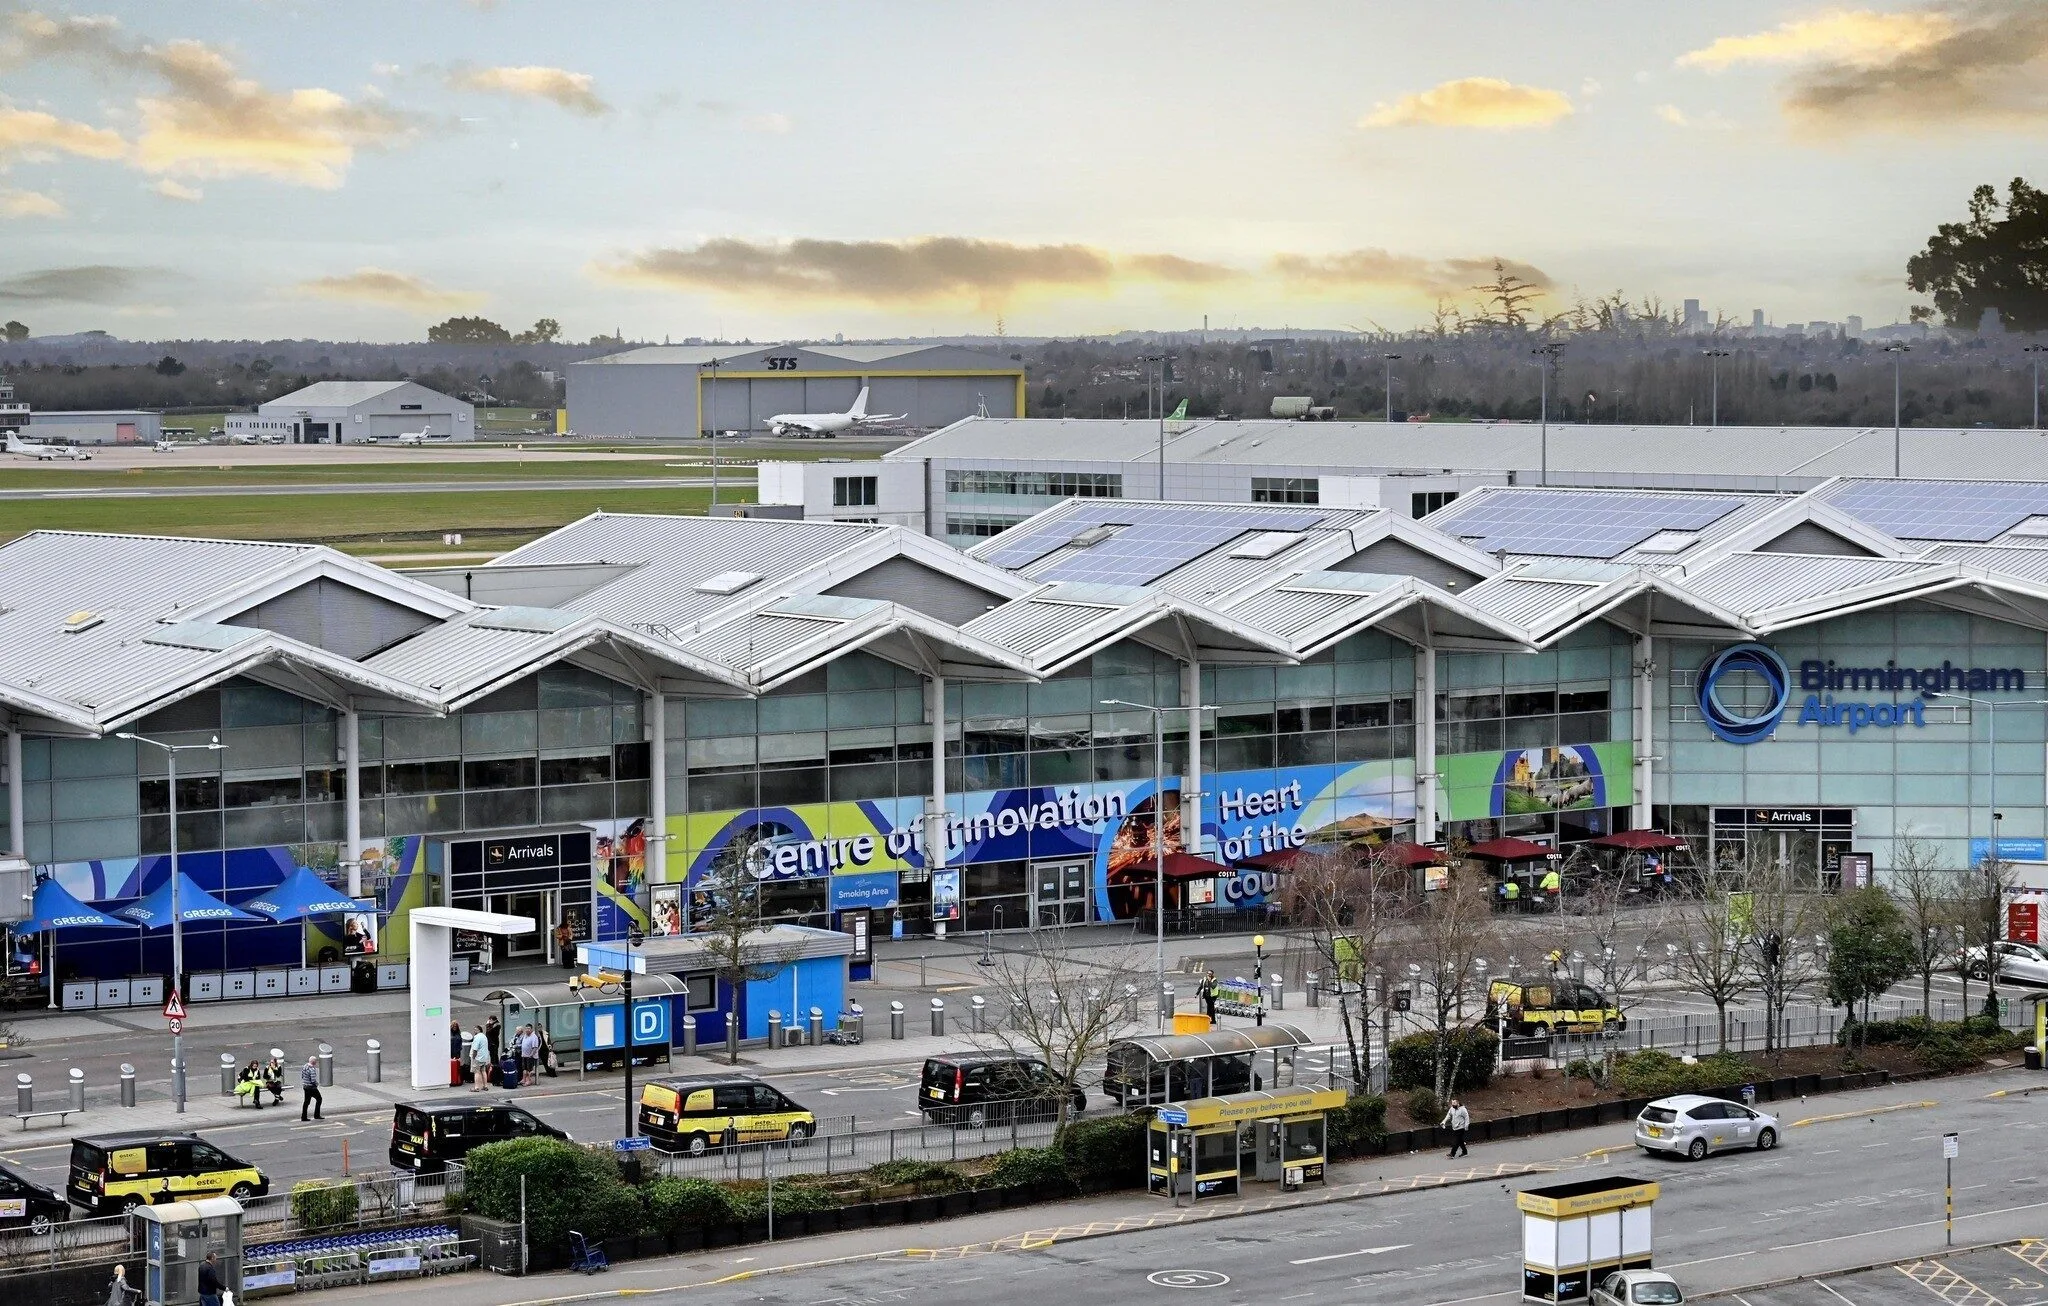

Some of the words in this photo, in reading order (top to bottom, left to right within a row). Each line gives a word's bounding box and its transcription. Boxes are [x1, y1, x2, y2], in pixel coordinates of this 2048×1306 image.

[767, 357, 798, 370] STS
[1800, 659, 2025, 699] Birmingham
[1798, 694, 1926, 735] Airport
[1221, 779, 1303, 821] Heart
[1771, 811, 1812, 822] Arrivals
[745, 832, 875, 879] Centre
[887, 813, 924, 855] of
[946, 786, 1127, 848] nnovation
[1225, 825, 1253, 860] of
[1260, 820, 1307, 853] the
[508, 844, 554, 860] Arrivals
[838, 889, 871, 899] Smoking
[872, 887, 889, 896] Area
[183, 908, 233, 919] GREGGS
[250, 900, 281, 914] GREGGS
[308, 901, 357, 913] GREGGS
[53, 915, 104, 926] GREGGS
[125, 907, 155, 921] GREGGS
[171, 1021, 180, 1030] 20
[640, 1012, 657, 1034] D
[1219, 1107, 1245, 1117] Please
[1245, 1105, 1259, 1116] pay
[1260, 1102, 1284, 1113] before
[1284, 1101, 1298, 1111] you
[1299, 1098, 1313, 1108] exit
[411, 1135, 424, 1145] TAXI
[87, 1173, 99, 1182] TAXI
[1570, 1199, 1591, 1208] Please
